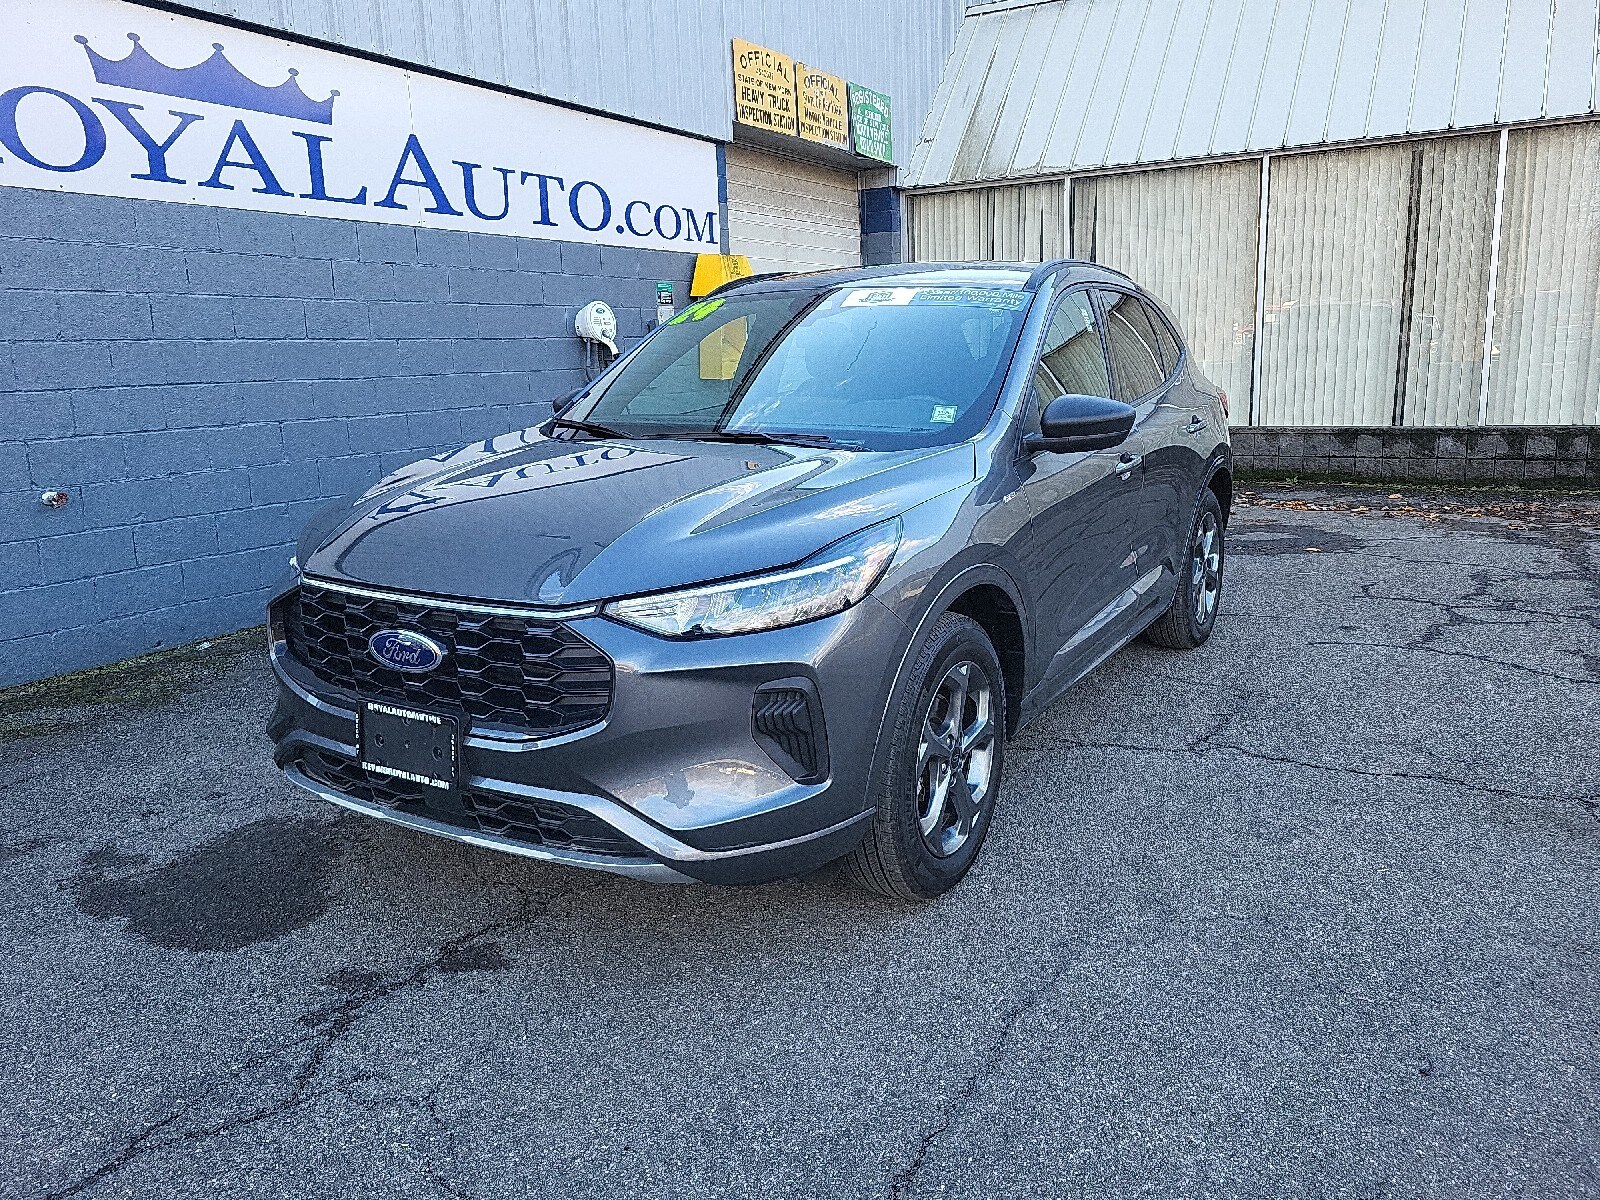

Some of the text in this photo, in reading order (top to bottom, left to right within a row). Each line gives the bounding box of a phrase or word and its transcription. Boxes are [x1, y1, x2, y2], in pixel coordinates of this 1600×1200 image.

[737, 73, 755, 86] STATE
[739, 51, 790, 84] OFFICIAL
[741, 86, 791, 112] HEAVY TRUCK
[803, 74, 840, 103] OFFICIAL
[739, 102, 795, 131] INSPECTION STATION
[0, 85, 718, 245] OYALAUTO.COM
[966, 295, 1023, 306] Warranty
[382, 637, 422, 666] Ford
